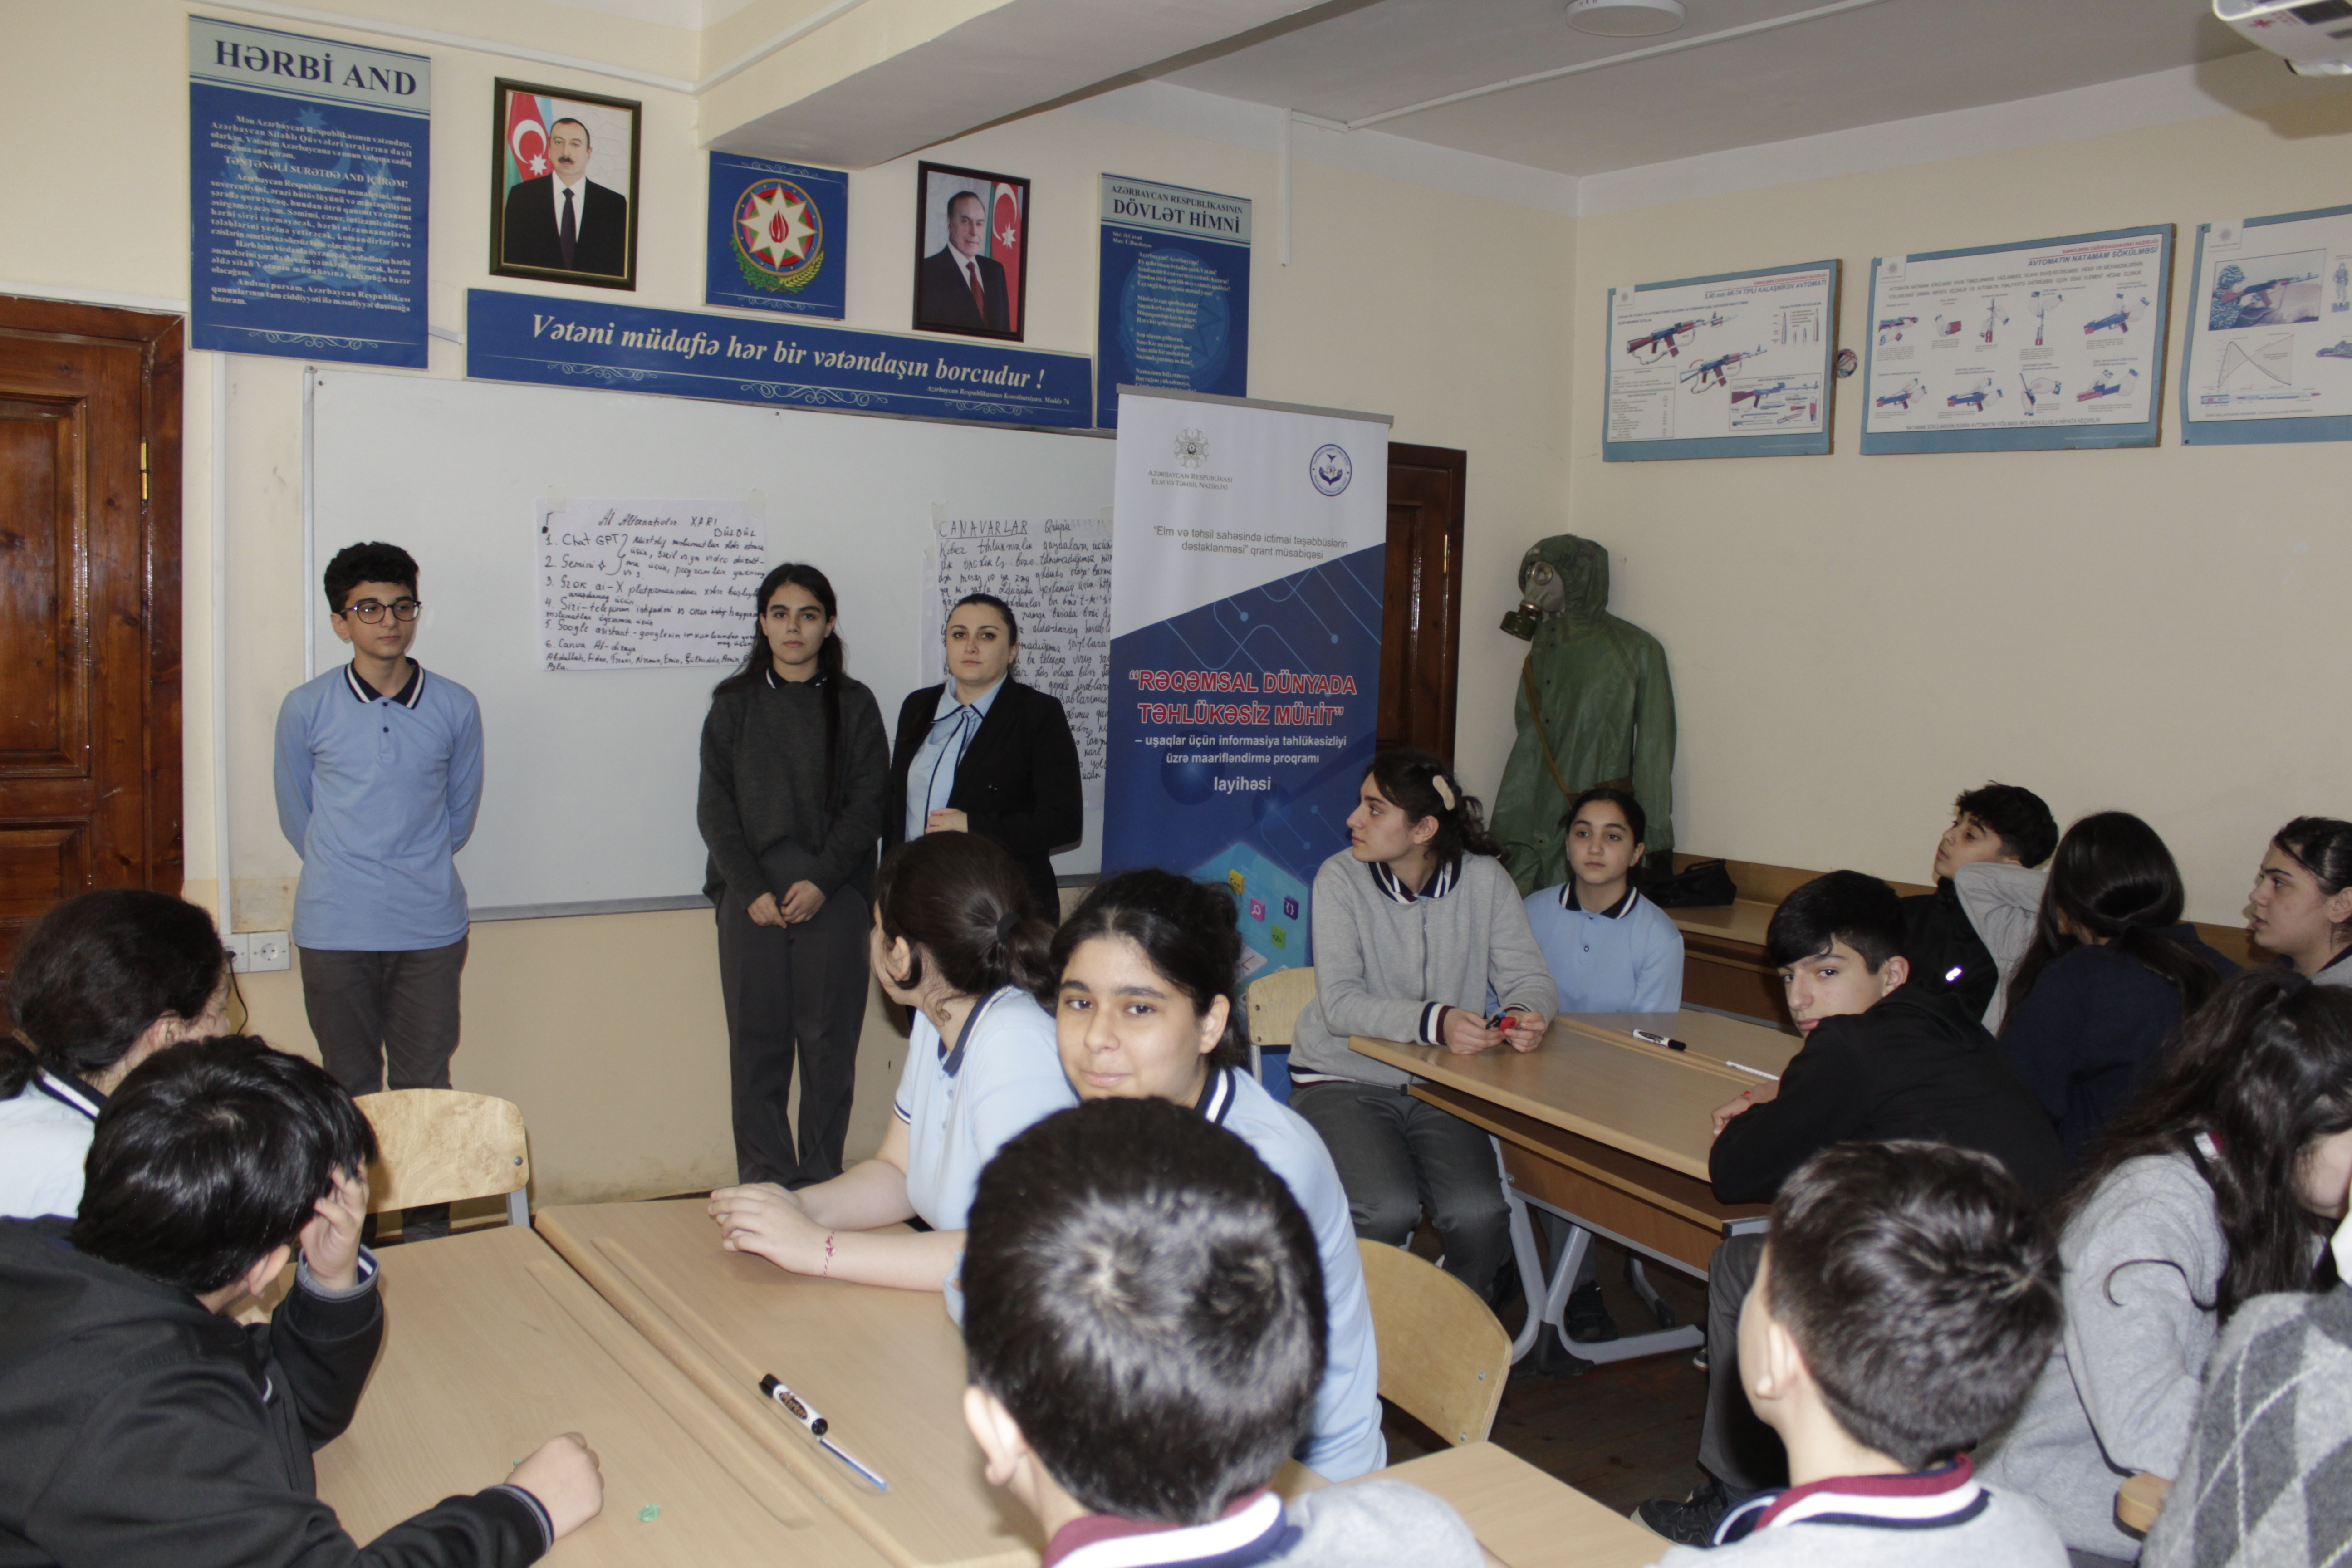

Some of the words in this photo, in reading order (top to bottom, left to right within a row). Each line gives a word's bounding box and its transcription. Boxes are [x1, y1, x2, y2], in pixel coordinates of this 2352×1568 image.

[214, 40, 334, 83] HƏRBİ
[343, 64, 416, 95] AND
[212, 121, 265, 135] Azərbaycan
[267, 129, 297, 140] Silahlı
[345, 143, 387, 153] sıralarına
[390, 148, 411, 157] daxil
[236, 115, 254, 124] Mən
[256, 118, 304, 132] Azərbaycan
[306, 126, 371, 142] Respublikasının
[224, 156, 287, 172] TƏNTƏNƏLİ
[290, 165, 341, 179] SURƏTDƏ
[343, 172, 364, 182] AND
[367, 174, 408, 188] İÇİRƏM!
[1111, 184, 1168, 201] AZƏRBAYCAN
[1171, 195, 1242, 214] RESPUBLİKASININ
[211, 208, 235, 217] hərbi
[317, 221, 340, 230] hərbi
[342, 225, 410, 239] nizamnamələrin
[1113, 197, 1185, 224] DÖVLƏT
[1190, 210, 1240, 233] HİMNİ
[211, 217, 258, 229] tələblərini
[337, 233, 399, 246] komandirlərin
[2028, 256, 2070, 266] AVTOMATIN
[2071, 252, 2109, 262] NATAMAM
[2112, 246, 2158, 258] SÖKÜLMƏSİ
[237, 278, 269, 287] Andımı
[270, 283, 305, 293] pozsam,
[308, 285, 356, 297] Azərbaycan
[358, 291, 410, 302] Respublikası
[1758, 284, 1795, 292] KALAŞNİKOV
[1796, 280, 1826, 288] AVTOMATI
[211, 294, 246, 304] hazıram.
[211, 287, 265, 296] qanunlarının
[374, 302, 410, 313] daşımağa
[534, 314, 614, 345] Vətəni
[620, 325, 720, 355] müdafiə
[726, 335, 766, 360] hər
[773, 340, 806, 365] bir
[813, 347, 928, 380] vətəndaşın
[935, 358, 1029, 387] borcudur
[1036, 369, 1045, 389] !
[562, 532, 591, 545] Chat
[596, 534, 620, 545] GPT
[714, 527, 756, 537] BÜLBÜL
[939, 520, 1028, 537] CANAVARLAR
[1192, 528, 1213, 539] təhsil
[1217, 530, 1261, 542] sahəsində
[1264, 534, 1291, 544] ictimai
[1294, 536, 1348, 550] təşəbbüslərin
[706, 553, 728, 564] video
[1182, 540, 1248, 554] dəstəklənməsi”
[1250, 546, 1273, 558] qrant
[1275, 547, 1323, 561] müsabiqəsi
[558, 618, 589, 636] Google
[559, 638, 586, 649] Canva
[1128, 669, 1259, 692] “RƏQƏMSAL
[1263, 669, 1358, 696] DÜNYADA
[1137, 696, 1271, 726] TƏHLÜKƏSİZ
[1274, 700, 1344, 727] MÜHİT”
[1145, 734, 1186, 748] uşaqlar
[1188, 735, 1216, 748] üçün
[1219, 735, 1280, 747] informasiya
[1282, 735, 1347, 748] təhlükəsizliyi
[1166, 753, 1189, 763] üzrə
[1191, 752, 1271, 764] maarifləndirmə
[1273, 754, 1319, 766] proqramı
[1214, 776, 1271, 794] layihəsi
